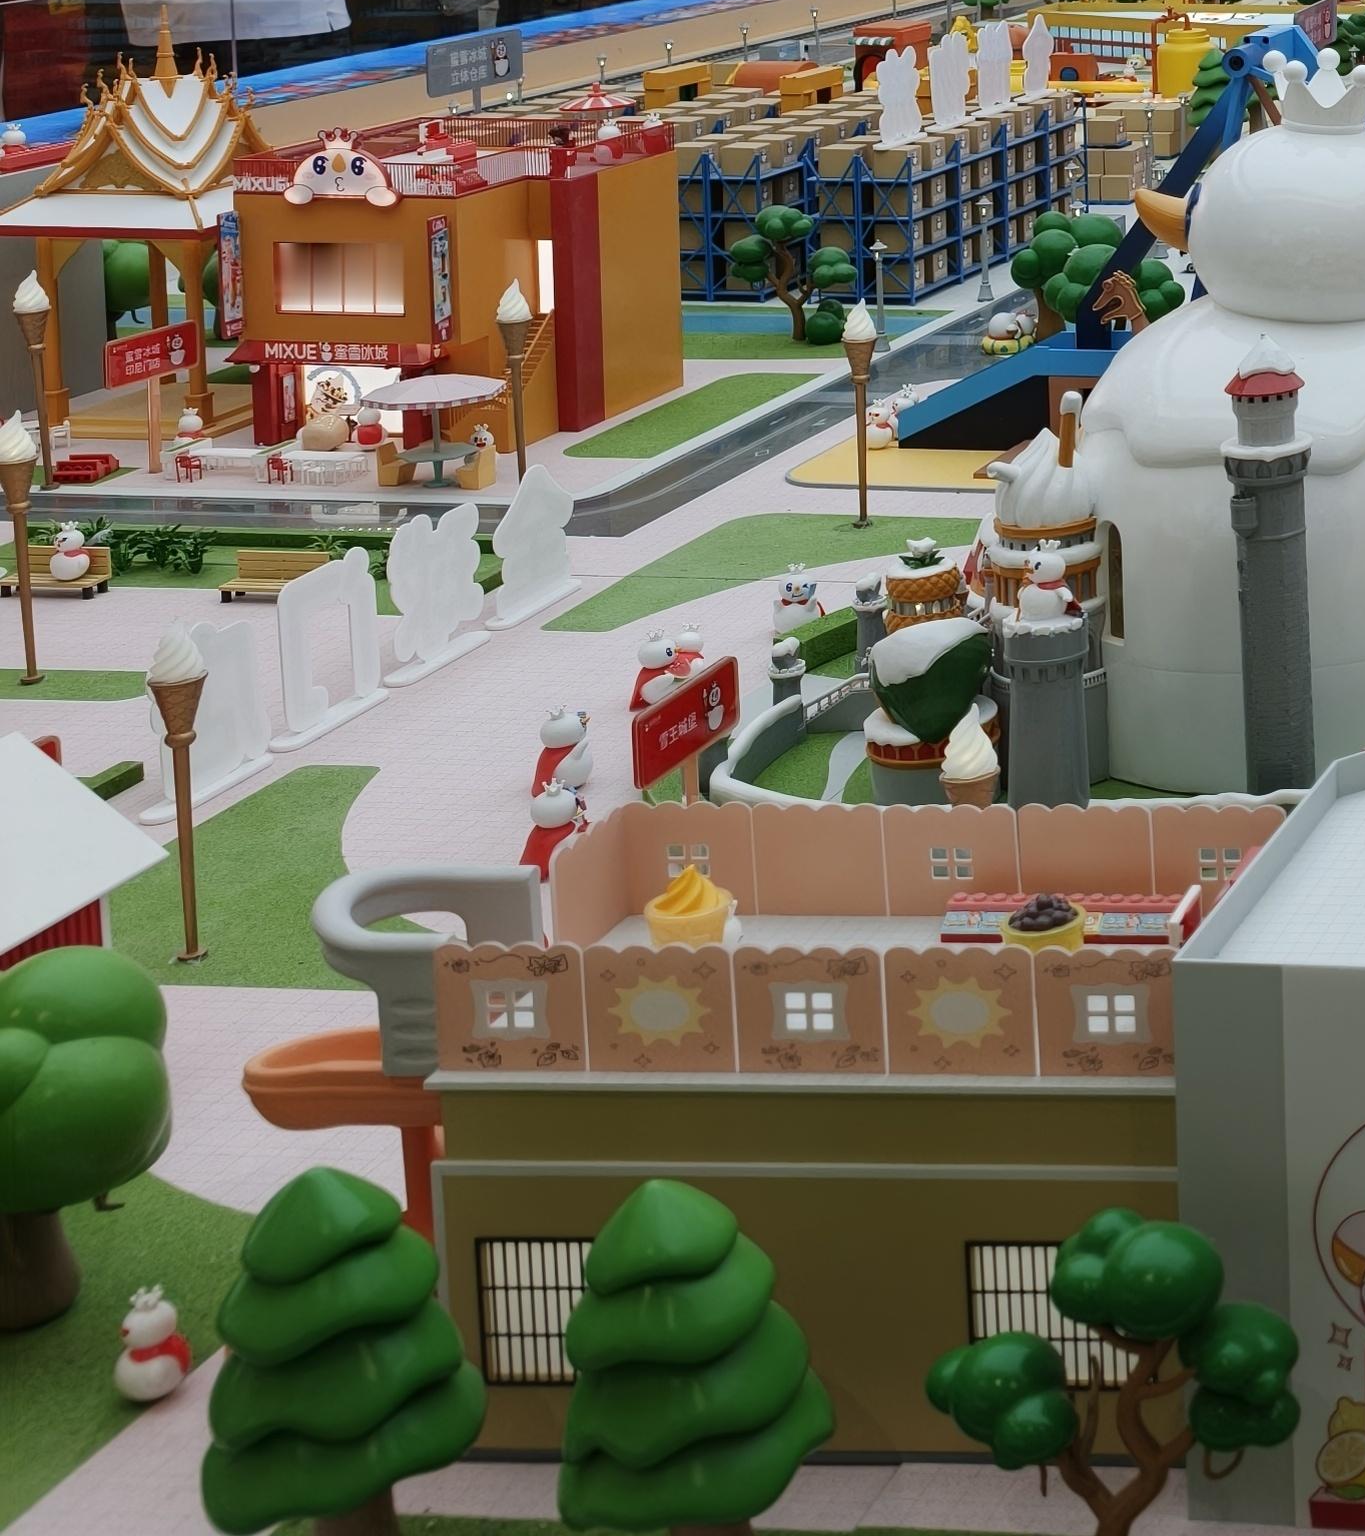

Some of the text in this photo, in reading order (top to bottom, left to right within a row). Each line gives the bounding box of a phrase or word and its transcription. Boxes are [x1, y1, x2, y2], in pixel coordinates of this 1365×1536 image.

[265, 343, 318, 360] MIXUE
[333, 344, 389, 361] 蜜雪冰城
